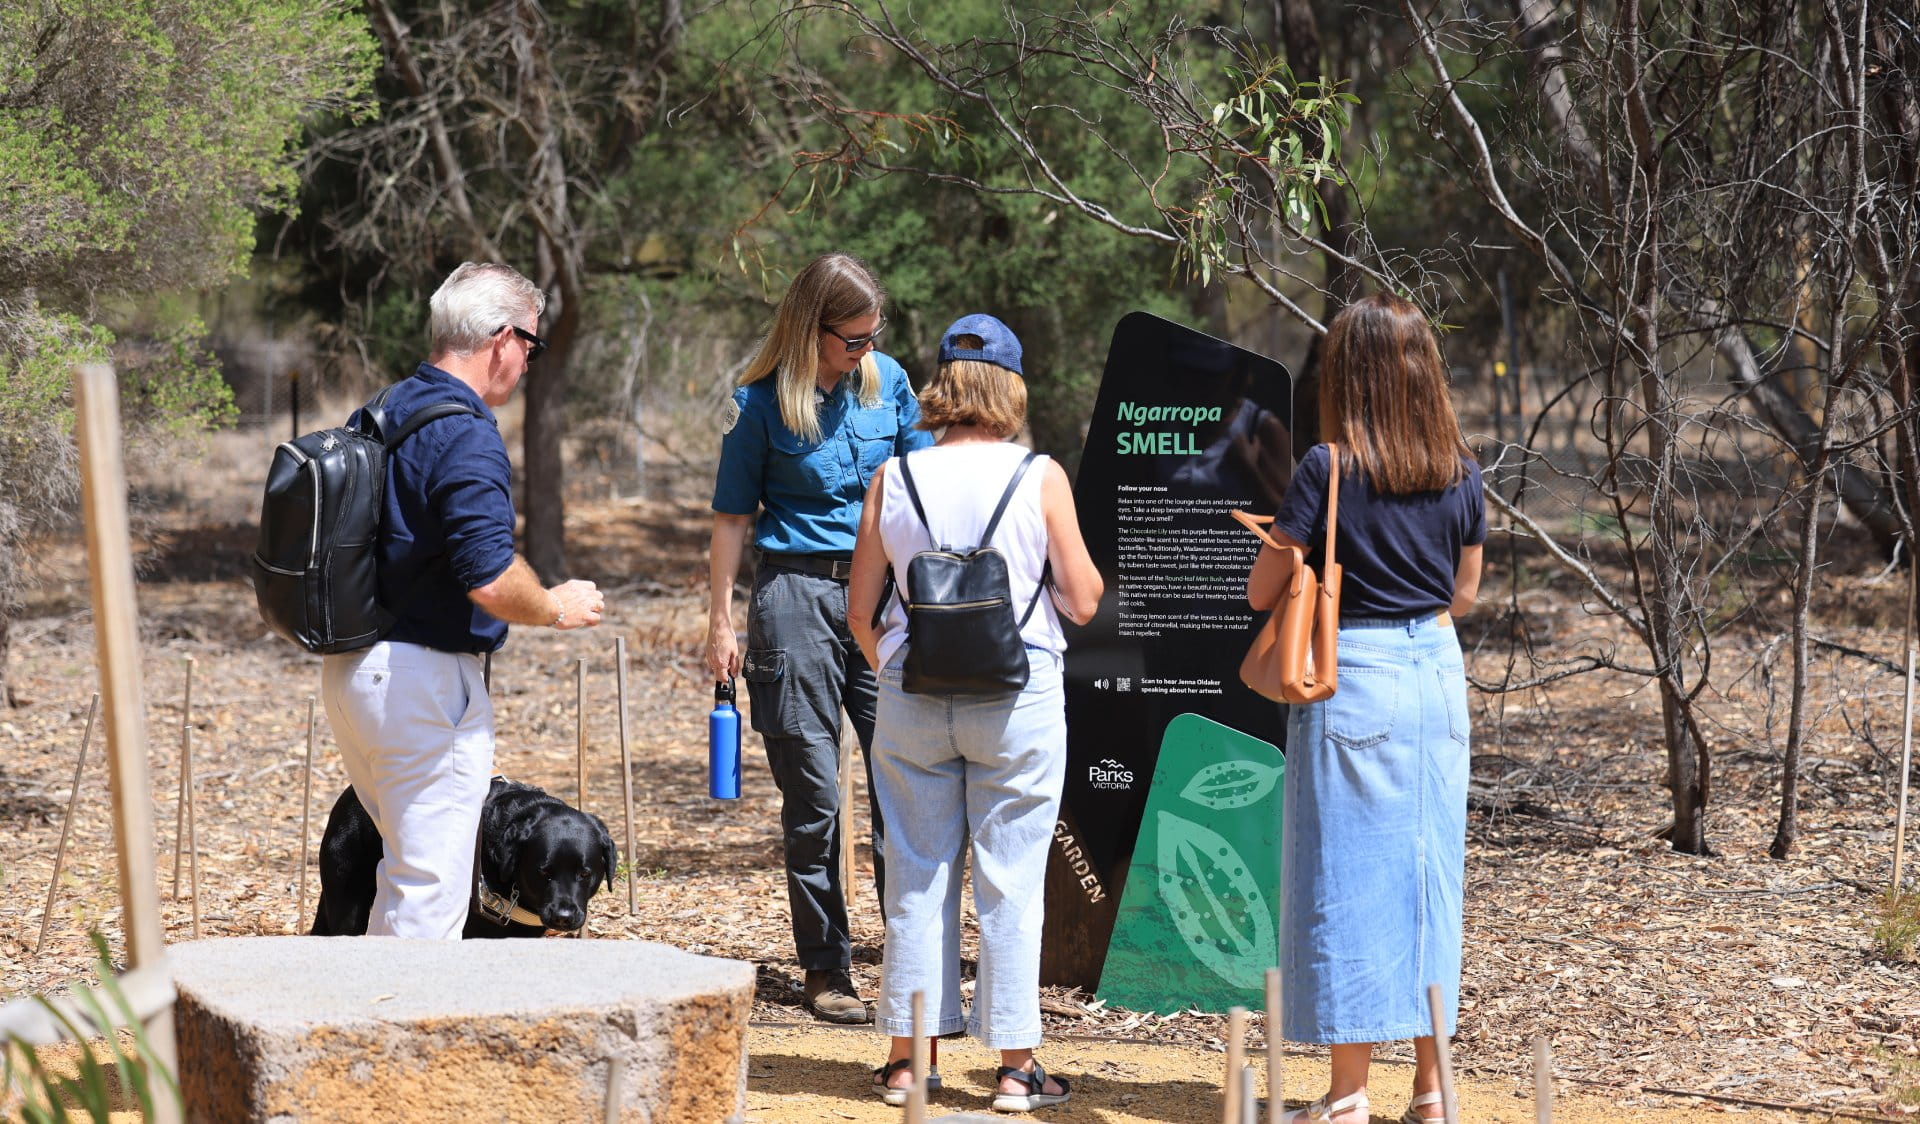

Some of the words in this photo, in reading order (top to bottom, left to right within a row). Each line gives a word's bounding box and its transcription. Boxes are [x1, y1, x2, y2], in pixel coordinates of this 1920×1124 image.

[1118, 402, 1222, 426] Ngarropa
[1116, 432, 1202, 454] SMELL
[1089, 766, 1134, 782] Parks
[1054, 820, 1106, 904] GARDEN
